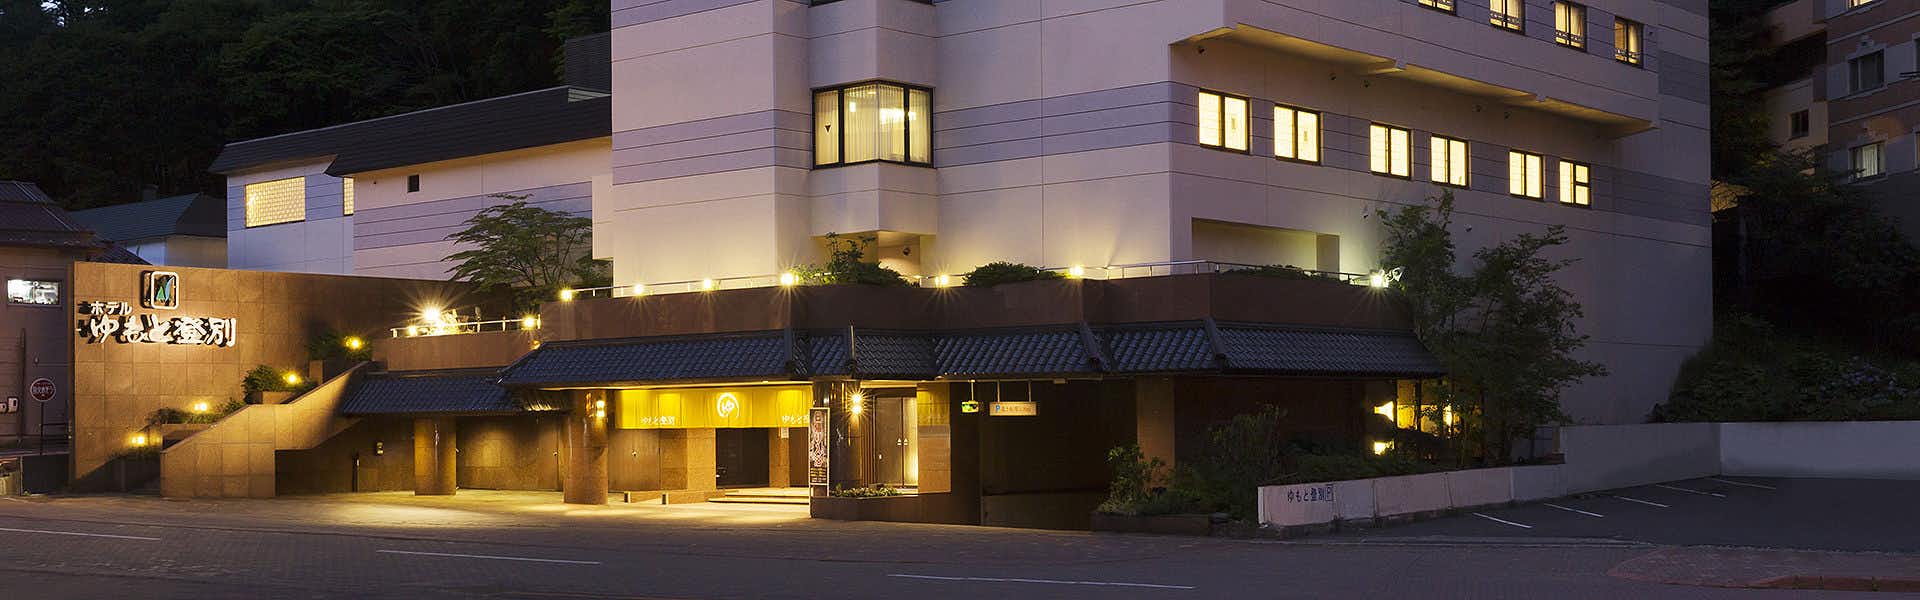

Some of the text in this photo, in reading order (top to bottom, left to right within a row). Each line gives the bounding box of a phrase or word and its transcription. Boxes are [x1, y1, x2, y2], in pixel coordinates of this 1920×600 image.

[90, 301, 132, 315] ホテル
[90, 315, 236, 347] ゆもと登別
